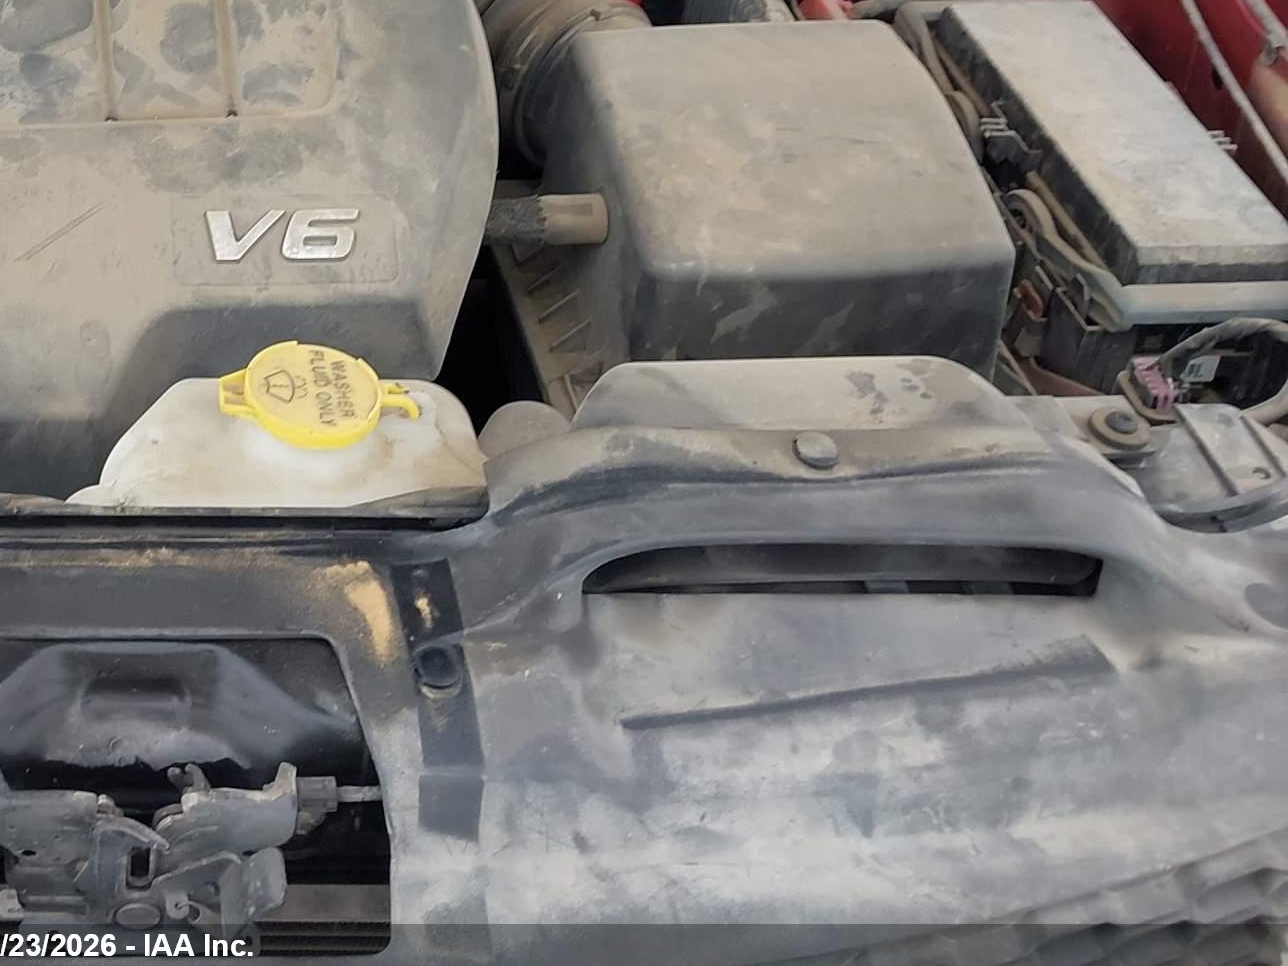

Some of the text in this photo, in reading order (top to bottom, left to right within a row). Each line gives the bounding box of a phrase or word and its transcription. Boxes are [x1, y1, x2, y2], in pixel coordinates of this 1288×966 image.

[205, 208, 361, 262] V6
[309, 349, 336, 427] FLUID ONLY
[330, 360, 355, 419] WASHER
